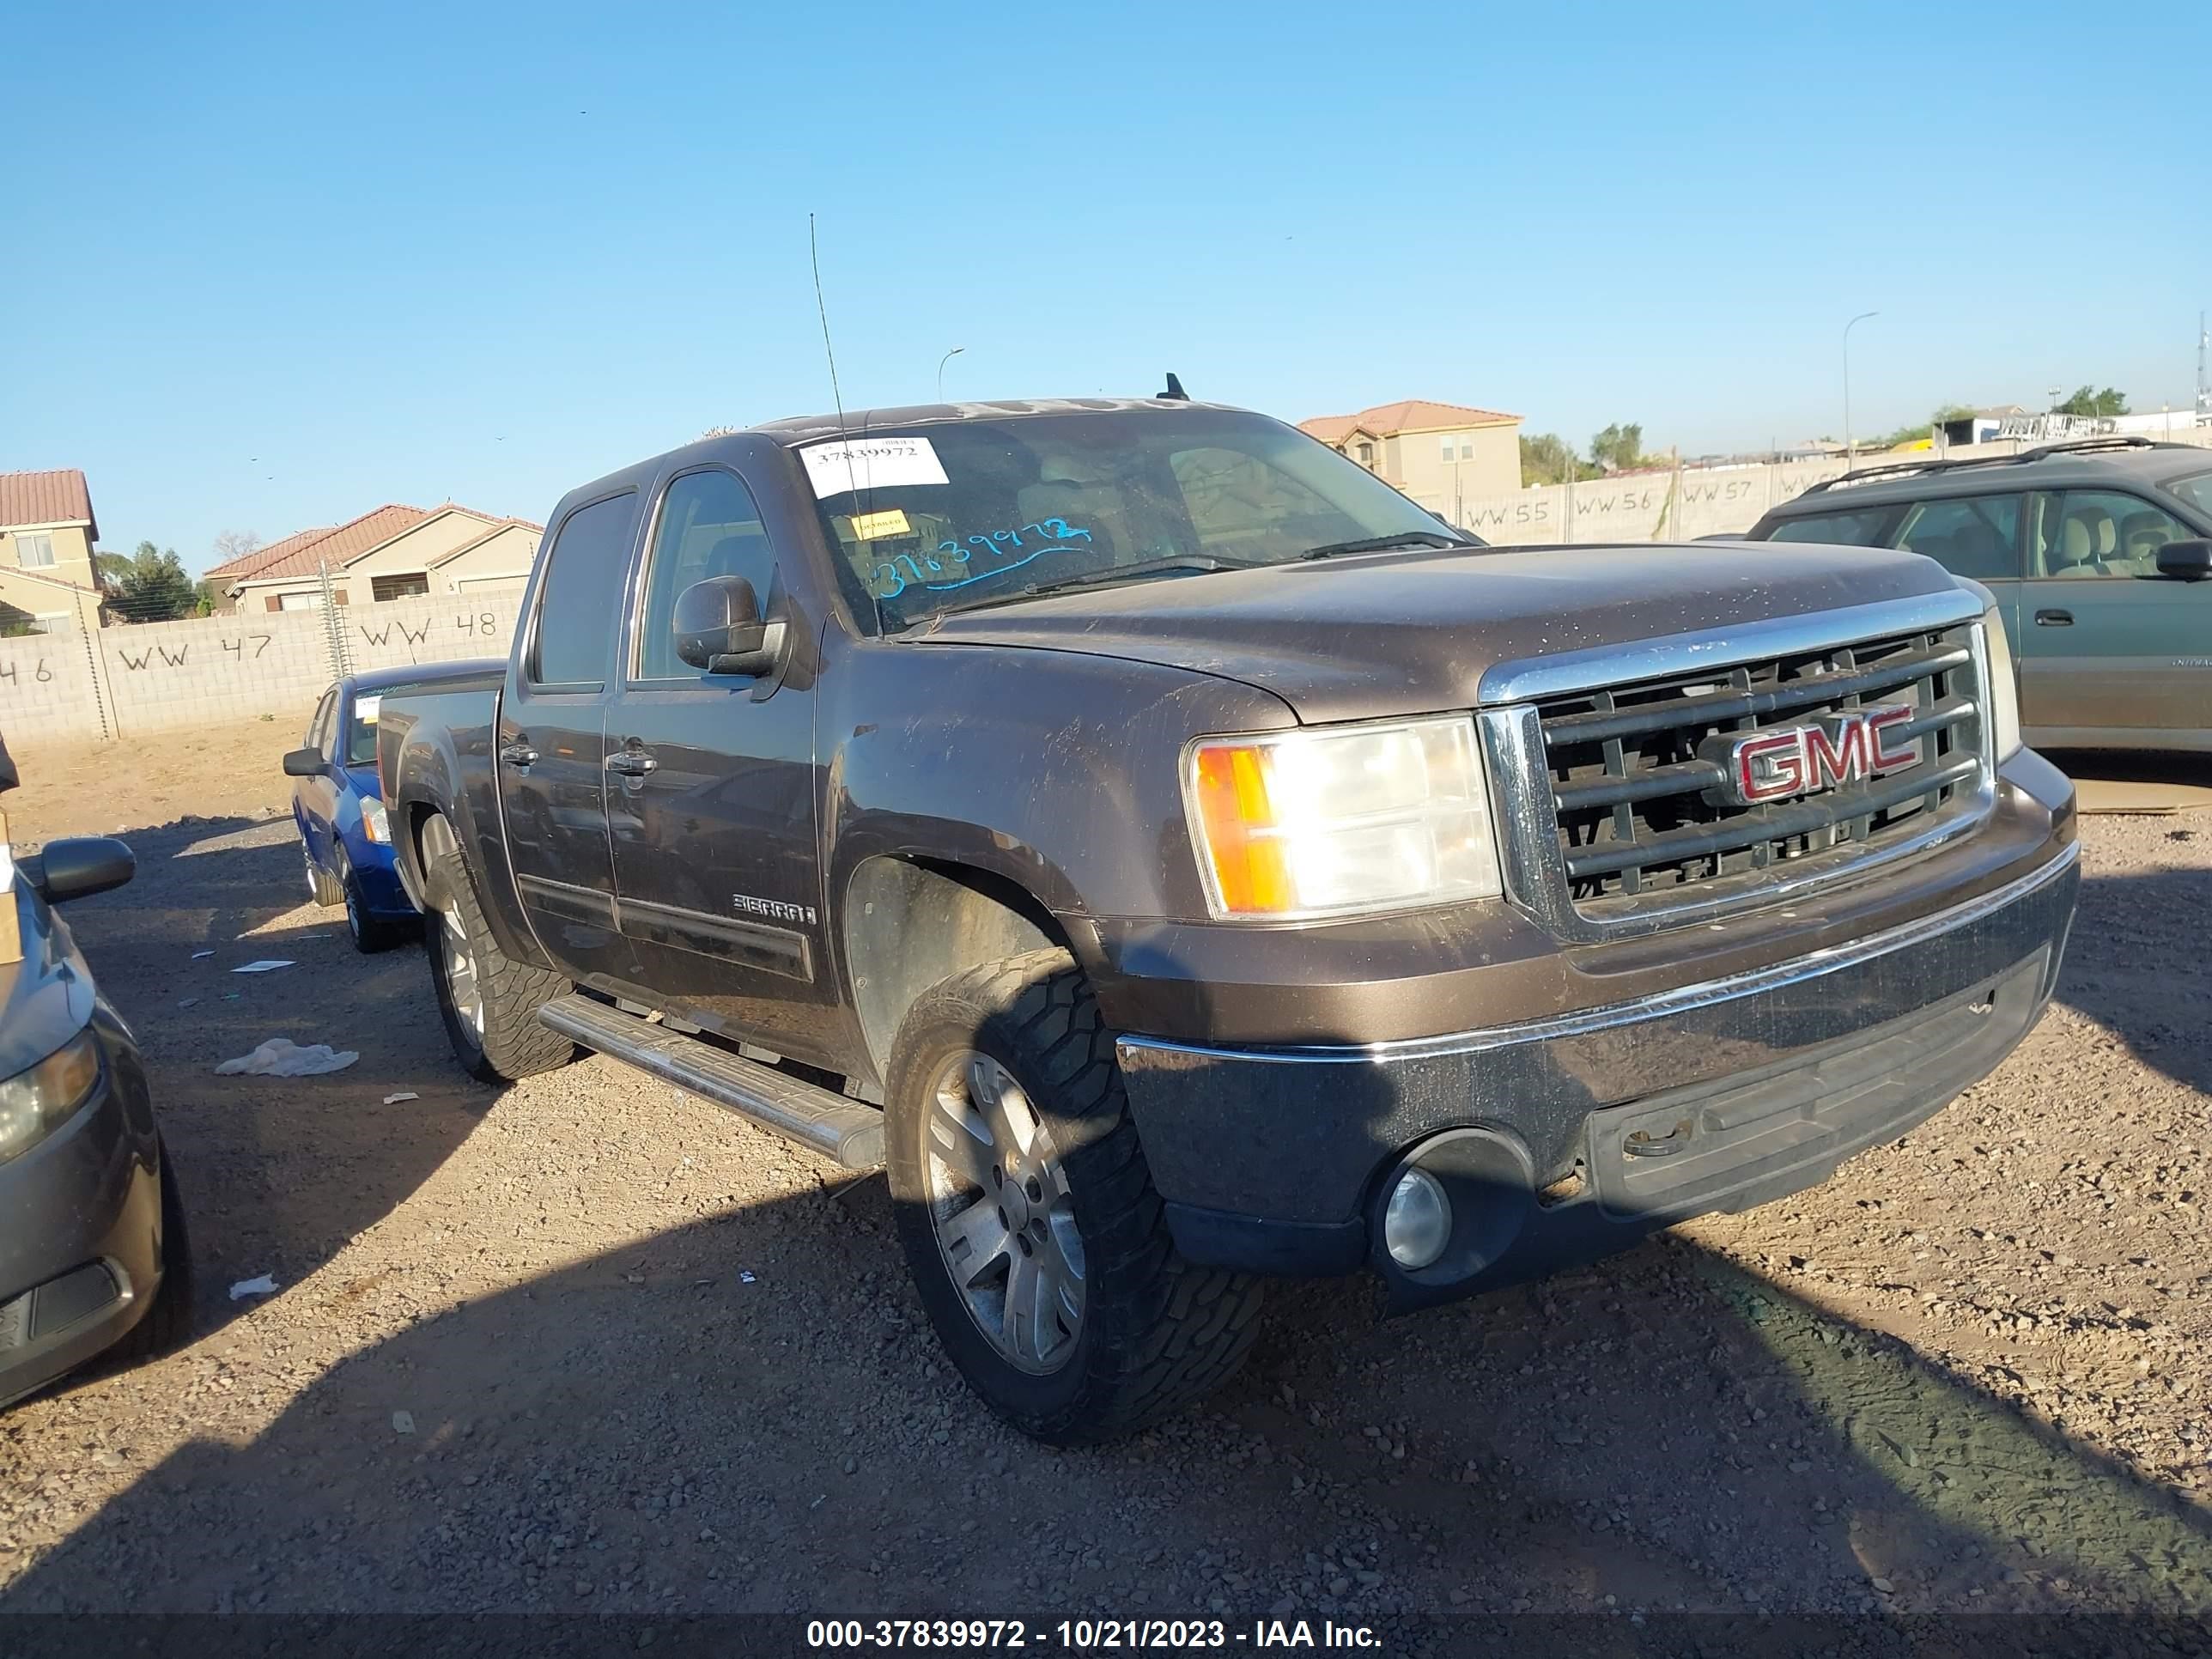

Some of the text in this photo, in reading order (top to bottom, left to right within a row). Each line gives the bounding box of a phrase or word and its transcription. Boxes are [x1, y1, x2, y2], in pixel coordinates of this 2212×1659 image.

[818, 447, 918, 465] 37839972
[1576, 493, 1651, 515] WW 56
[1684, 482, 1752, 503] WW 57
[1468, 502, 1548, 528] WW 55
[361, 612, 495, 647] WW 48
[118, 635, 271, 671] WW 47
[1733, 703, 1918, 803] GMC
[732, 893, 805, 922] SIERRA
